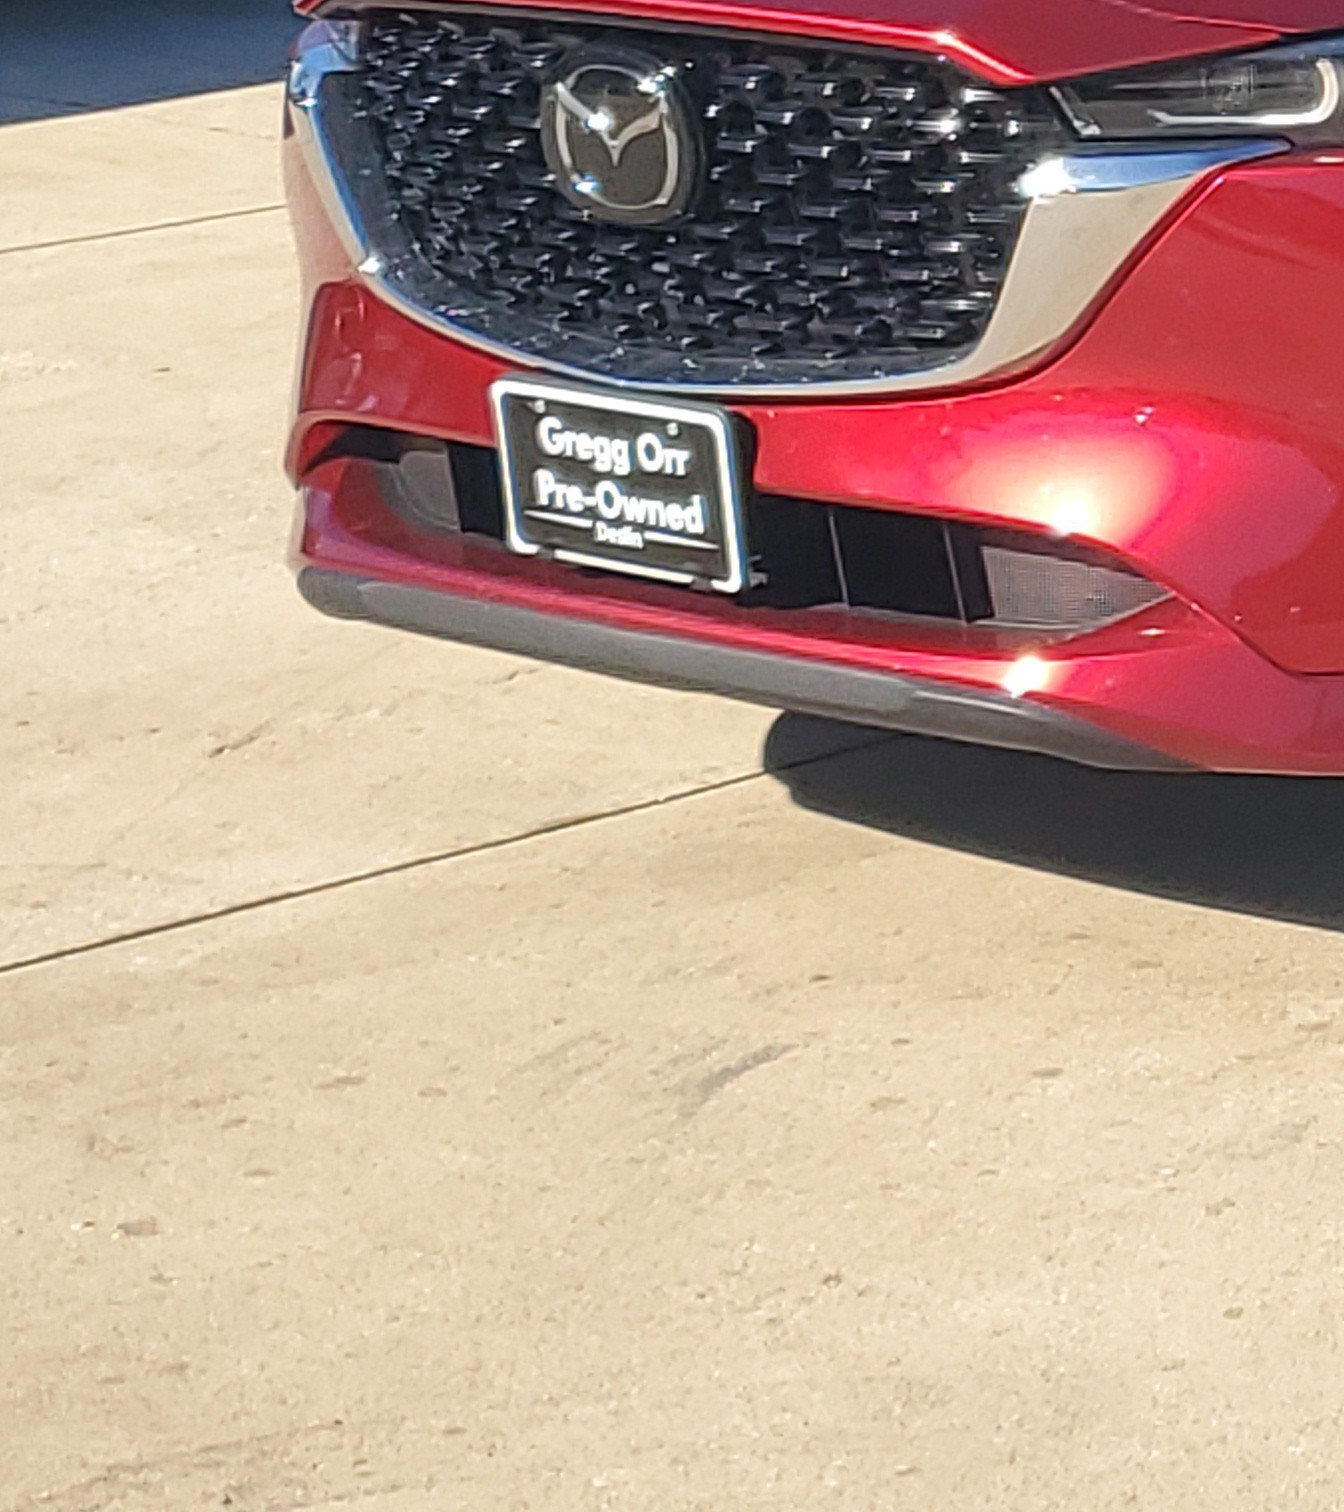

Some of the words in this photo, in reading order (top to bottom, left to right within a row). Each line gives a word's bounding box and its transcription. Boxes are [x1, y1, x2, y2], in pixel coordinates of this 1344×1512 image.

[535, 415, 632, 477] Gregg
[636, 432, 691, 476] Orr
[531, 467, 706, 535] Pre-Owned
